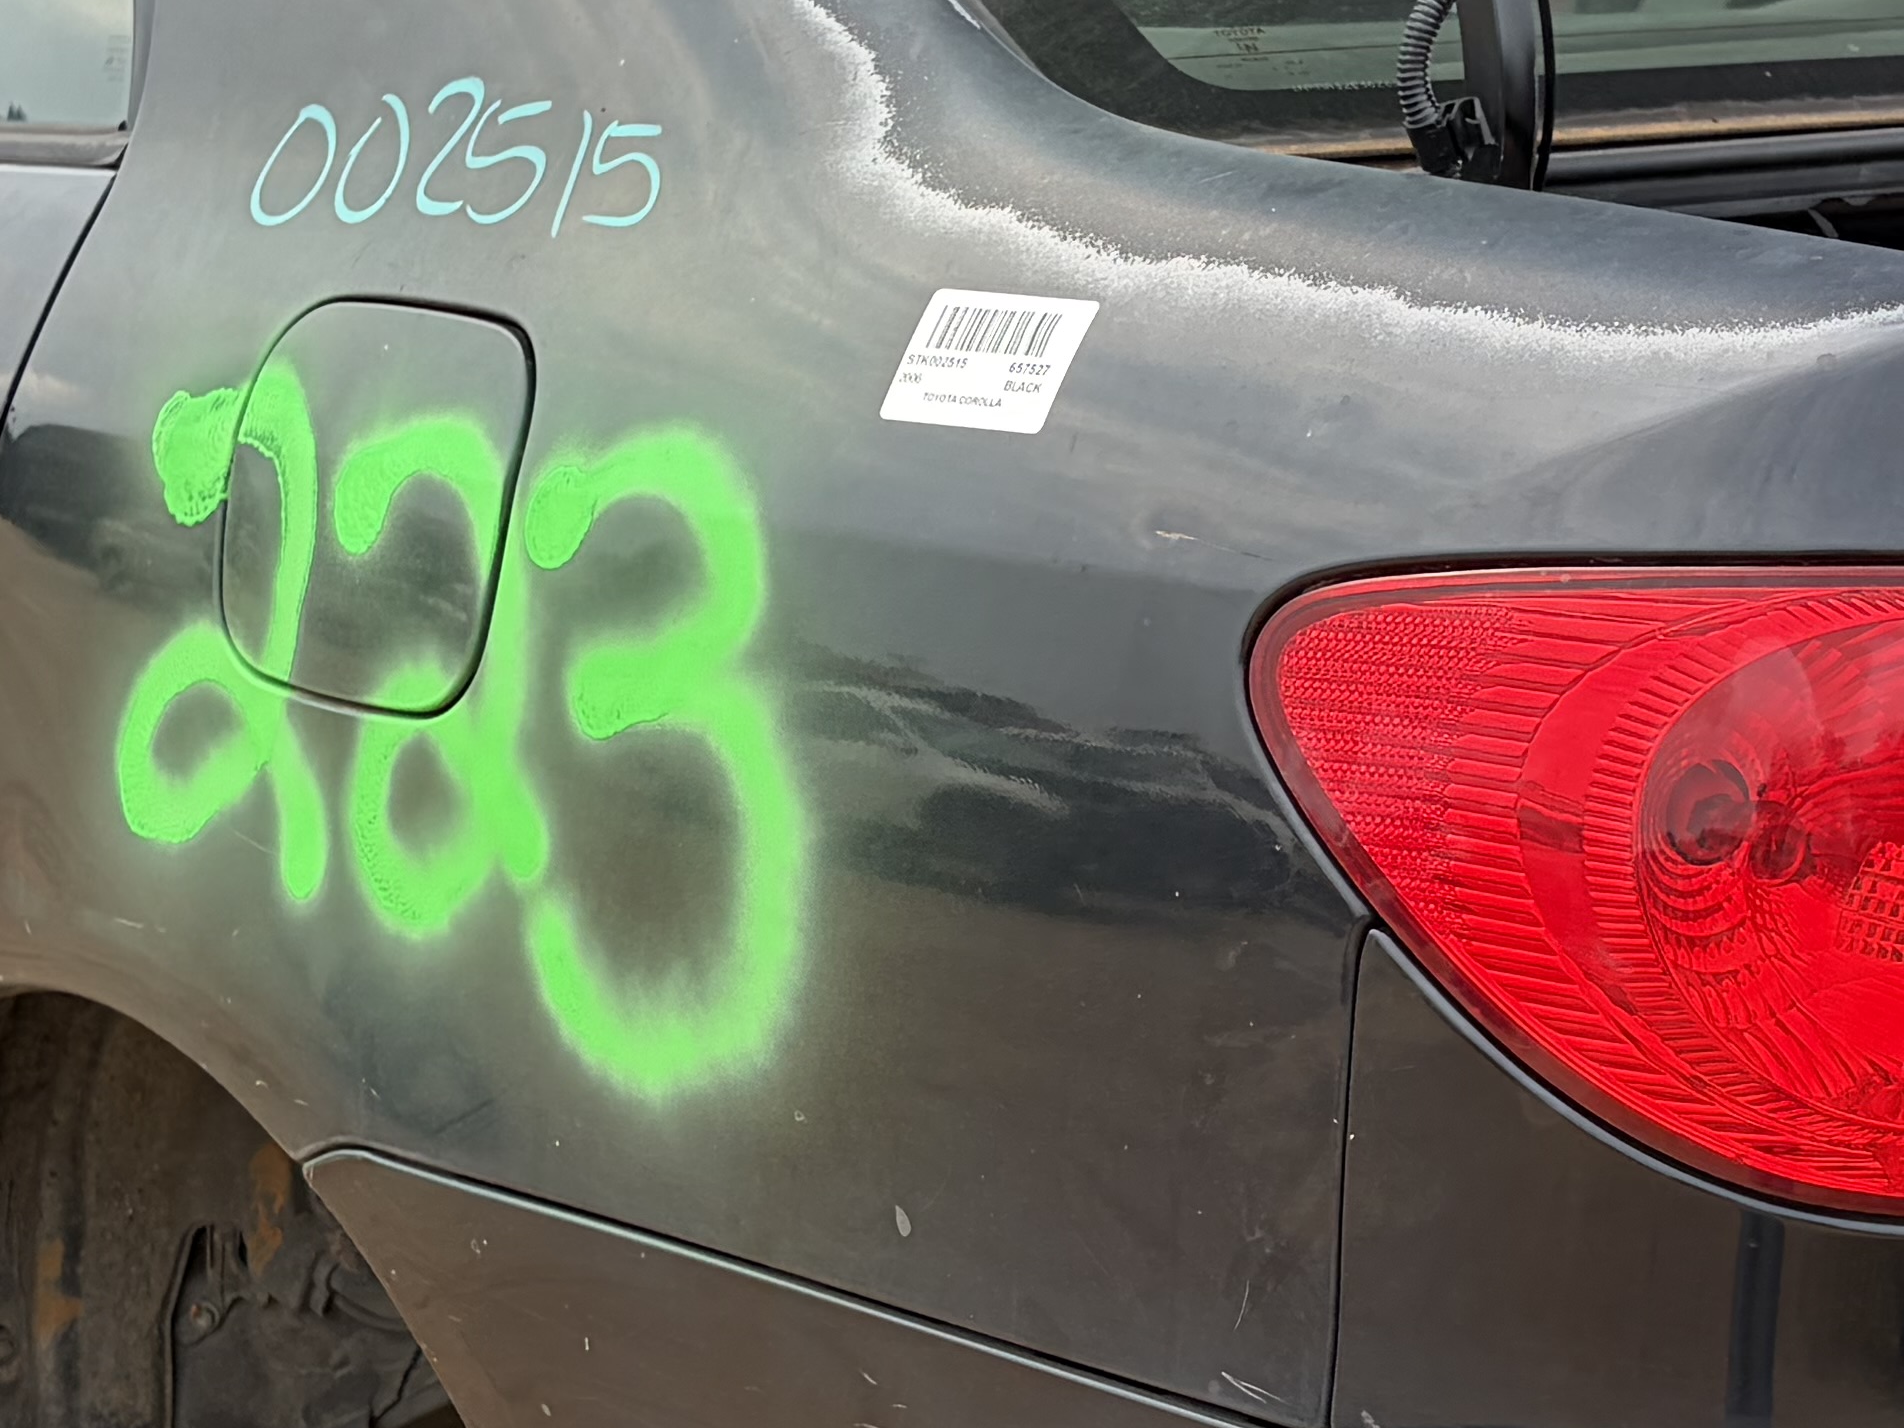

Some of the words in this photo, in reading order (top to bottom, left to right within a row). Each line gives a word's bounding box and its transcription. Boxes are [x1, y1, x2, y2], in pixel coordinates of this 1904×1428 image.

[249, 76, 663, 239] 002515
[906, 354, 968, 369] STK002515
[1008, 362, 1051, 376] 657527
[1003, 380, 1043, 394] BLACK
[922, 392, 957, 403] TOYOTA
[959, 395, 1003, 408] COROLLA
[116, 362, 812, 1107] 223
